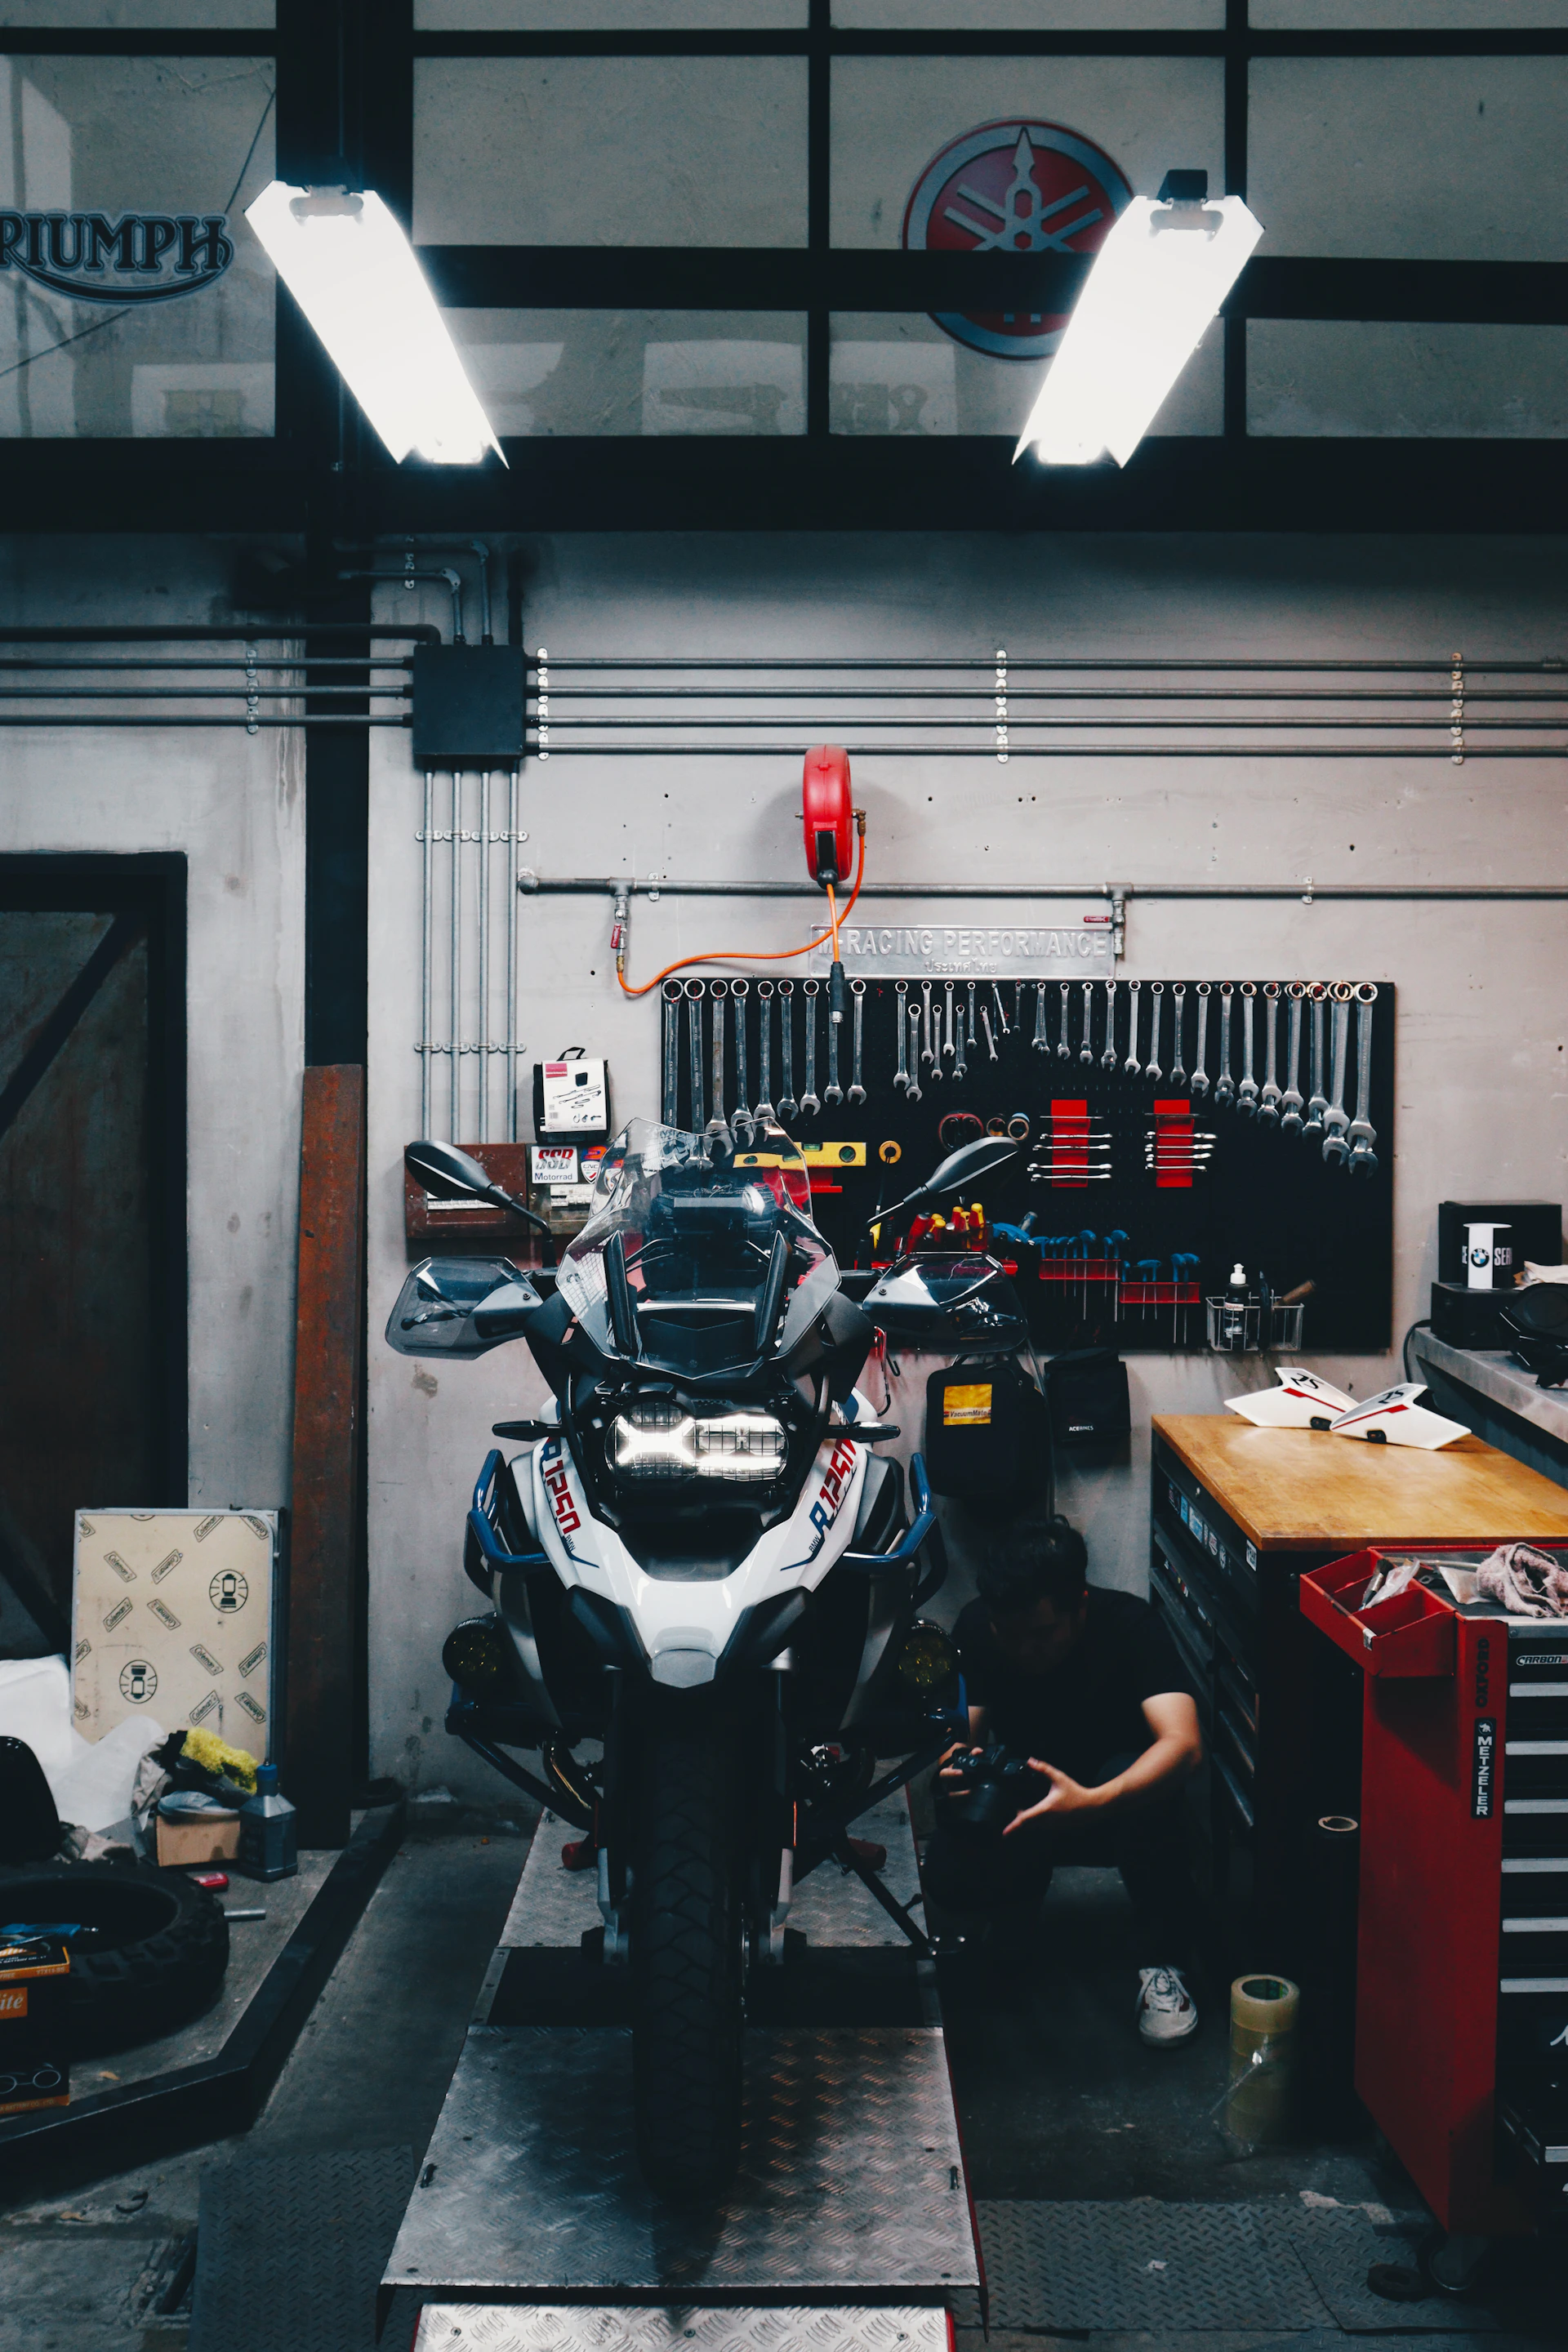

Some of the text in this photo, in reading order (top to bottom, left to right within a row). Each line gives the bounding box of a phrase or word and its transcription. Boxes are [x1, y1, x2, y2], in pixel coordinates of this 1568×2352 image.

[943, 930, 1107, 958] PERFORMANCE
[924, 957, 997, 973] ประเทศไทย
[534, 1172, 572, 1181] Motorrad
[950, 1410, 987, 1418] VacuumMate
[809, 1500, 835, 1536] R
[564, 1535, 577, 1551] BMW
[808, 1535, 820, 1552] BMW
[108, 1554, 129, 1576] Coleman
[159, 1554, 179, 1575] Coleman
[105, 1606, 125, 1627] Coleman
[156, 1606, 176, 1627] Coleman
[194, 1646, 215, 1668] Coleman
[246, 1647, 266, 1668] Coleman
[1517, 1655, 1561, 1665] CARBON
[1475, 1637, 1490, 1708] OXFORD
[192, 1699, 212, 1721] Coleman
[243, 1699, 265, 1721] Coleman
[1477, 1735, 1492, 1815] METZELER
